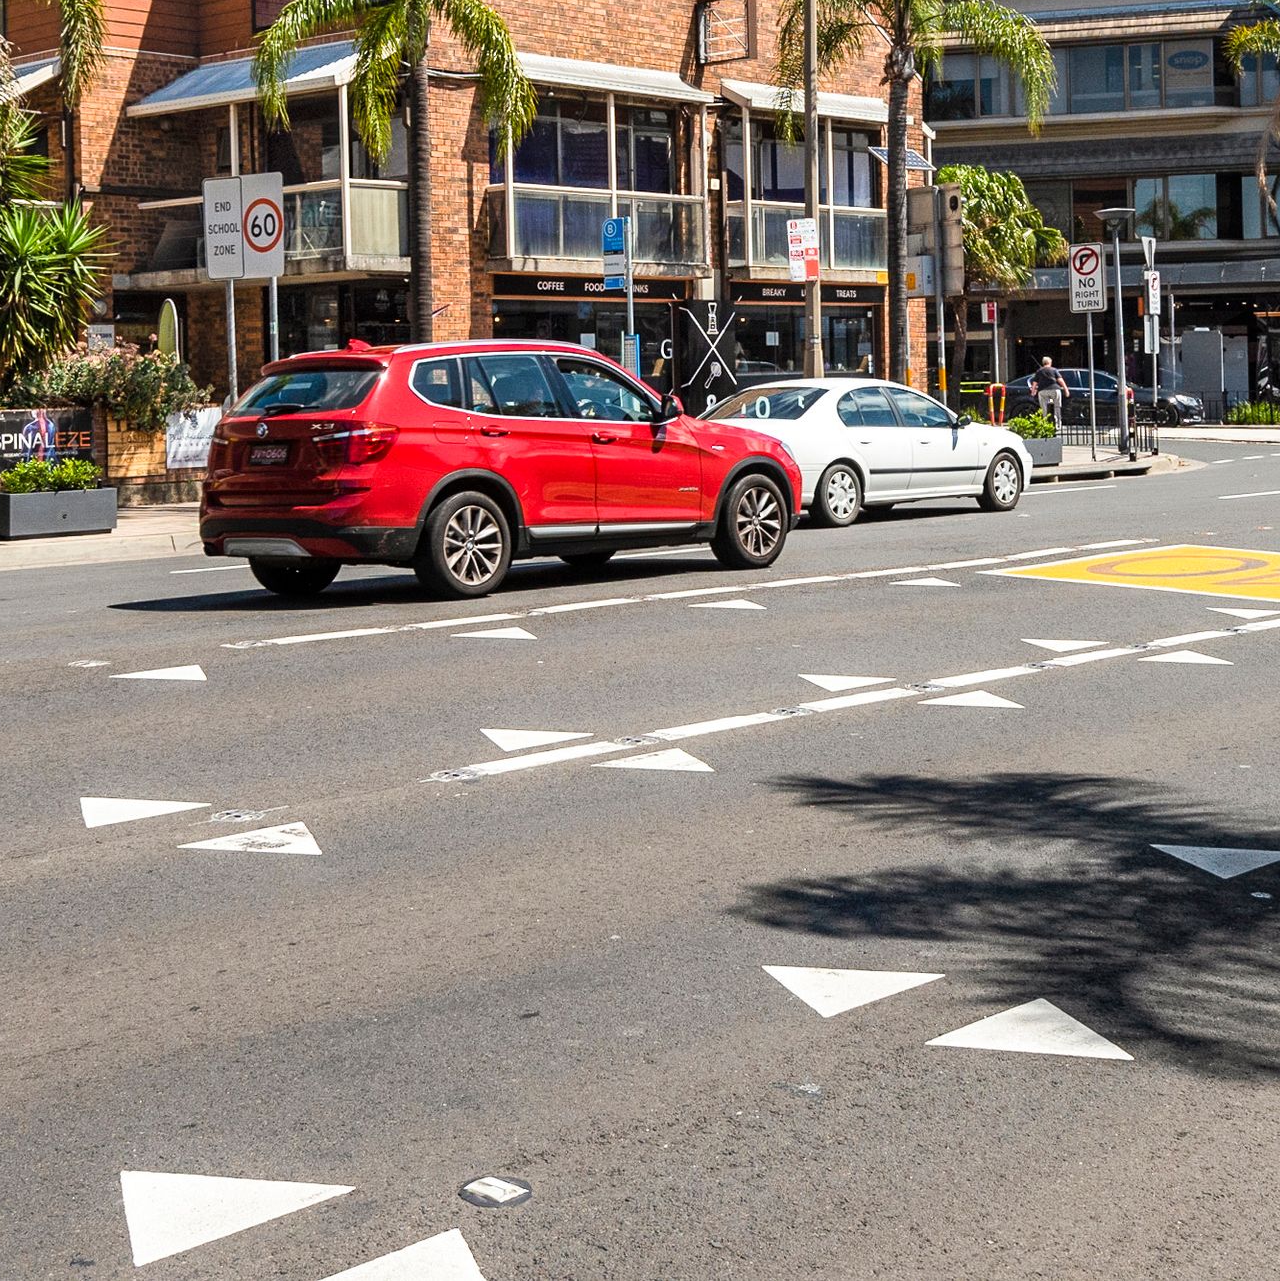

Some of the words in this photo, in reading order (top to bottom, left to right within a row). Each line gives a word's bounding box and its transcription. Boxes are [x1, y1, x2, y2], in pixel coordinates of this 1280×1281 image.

[214, 201, 232, 213] END
[207, 222, 240, 235] SCHOOL
[250, 212, 276, 238] 60
[213, 244, 236, 256] ZONE
[536, 281, 565, 291] COFFEE
[584, 282, 606, 292] FOOD
[1078, 277, 1096, 289] NO
[762, 288, 787, 297] BREAKY
[836, 289, 857, 298] TREATS
[1075, 290, 1100, 299] RIGHT
[1077, 299, 1100, 309] TURN
